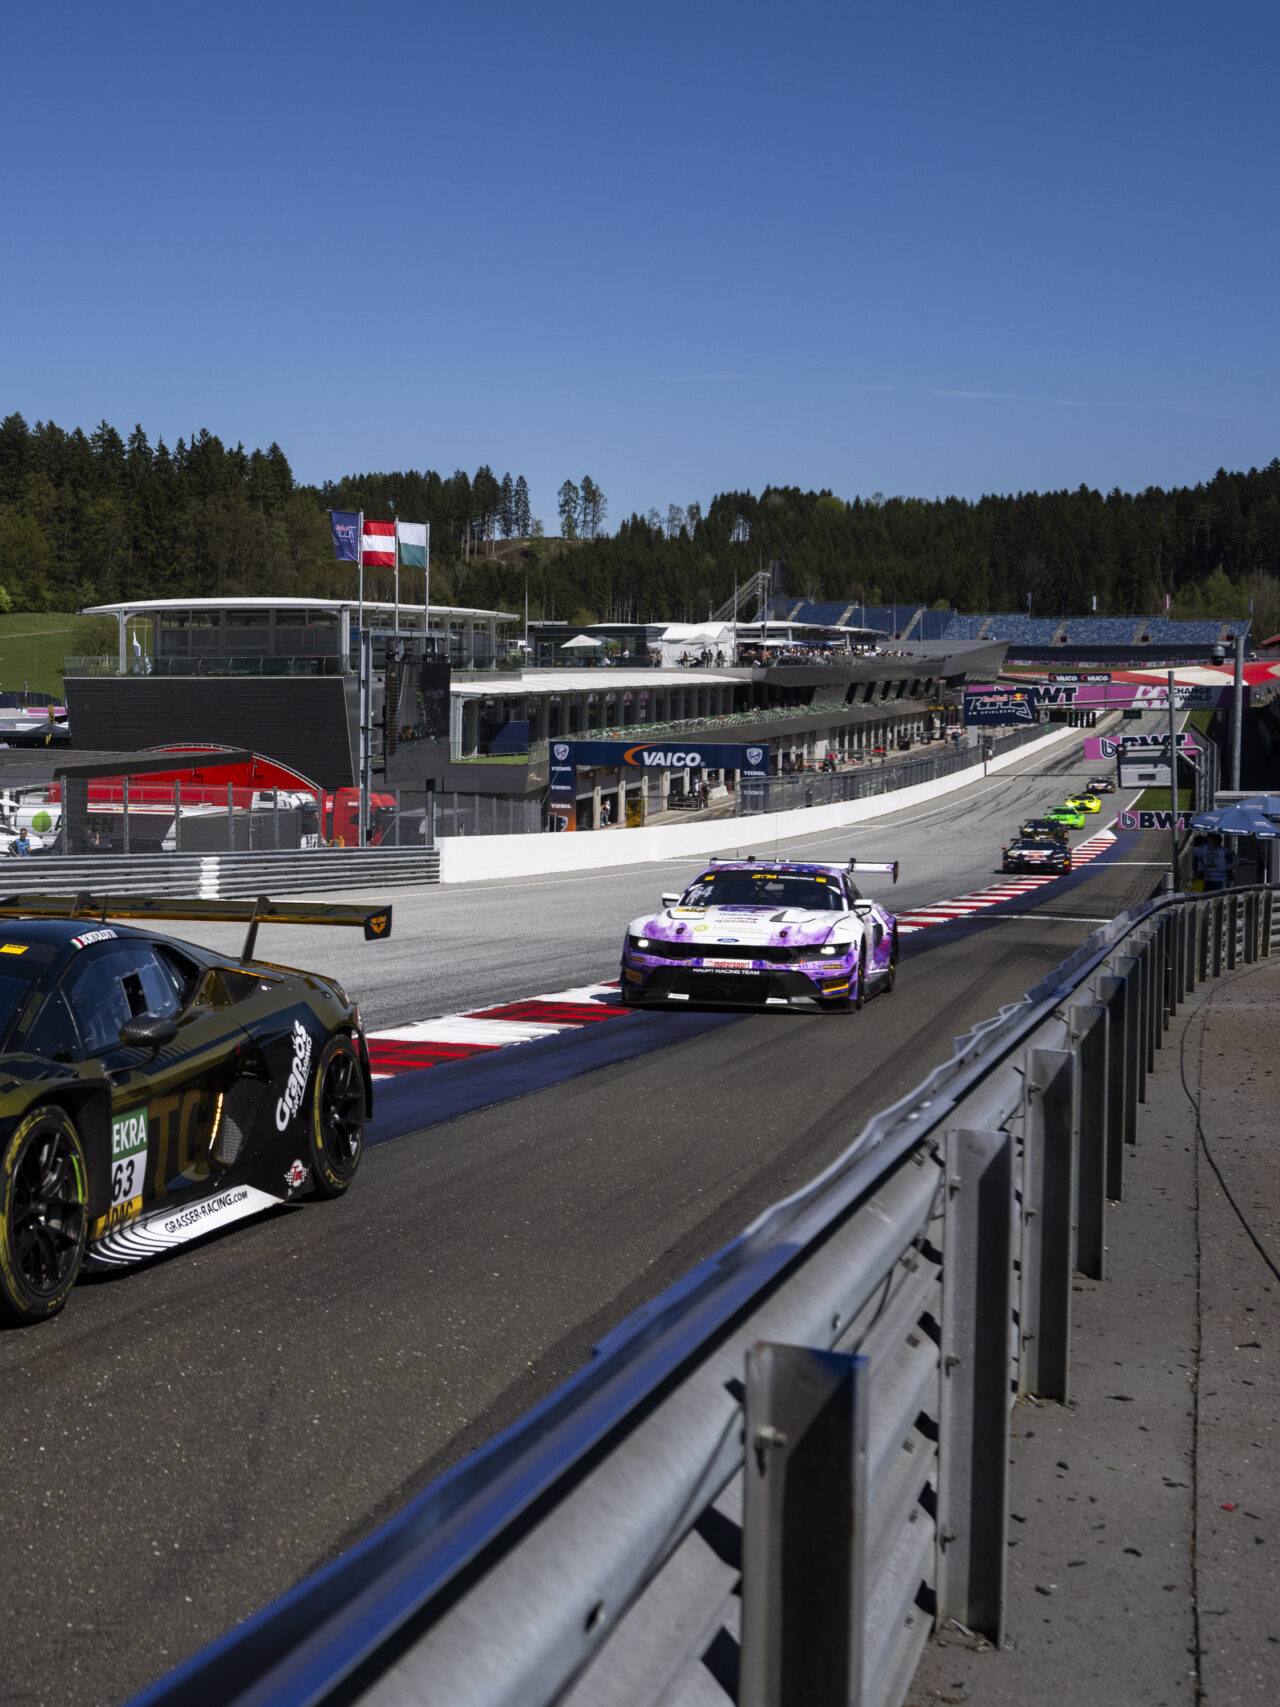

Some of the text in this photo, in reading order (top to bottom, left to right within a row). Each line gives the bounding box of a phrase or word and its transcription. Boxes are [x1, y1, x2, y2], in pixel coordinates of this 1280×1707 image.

[642, 751, 702, 767] VAICO
[112, 1114, 147, 1154] EKRA
[112, 1159, 135, 1203] 63
